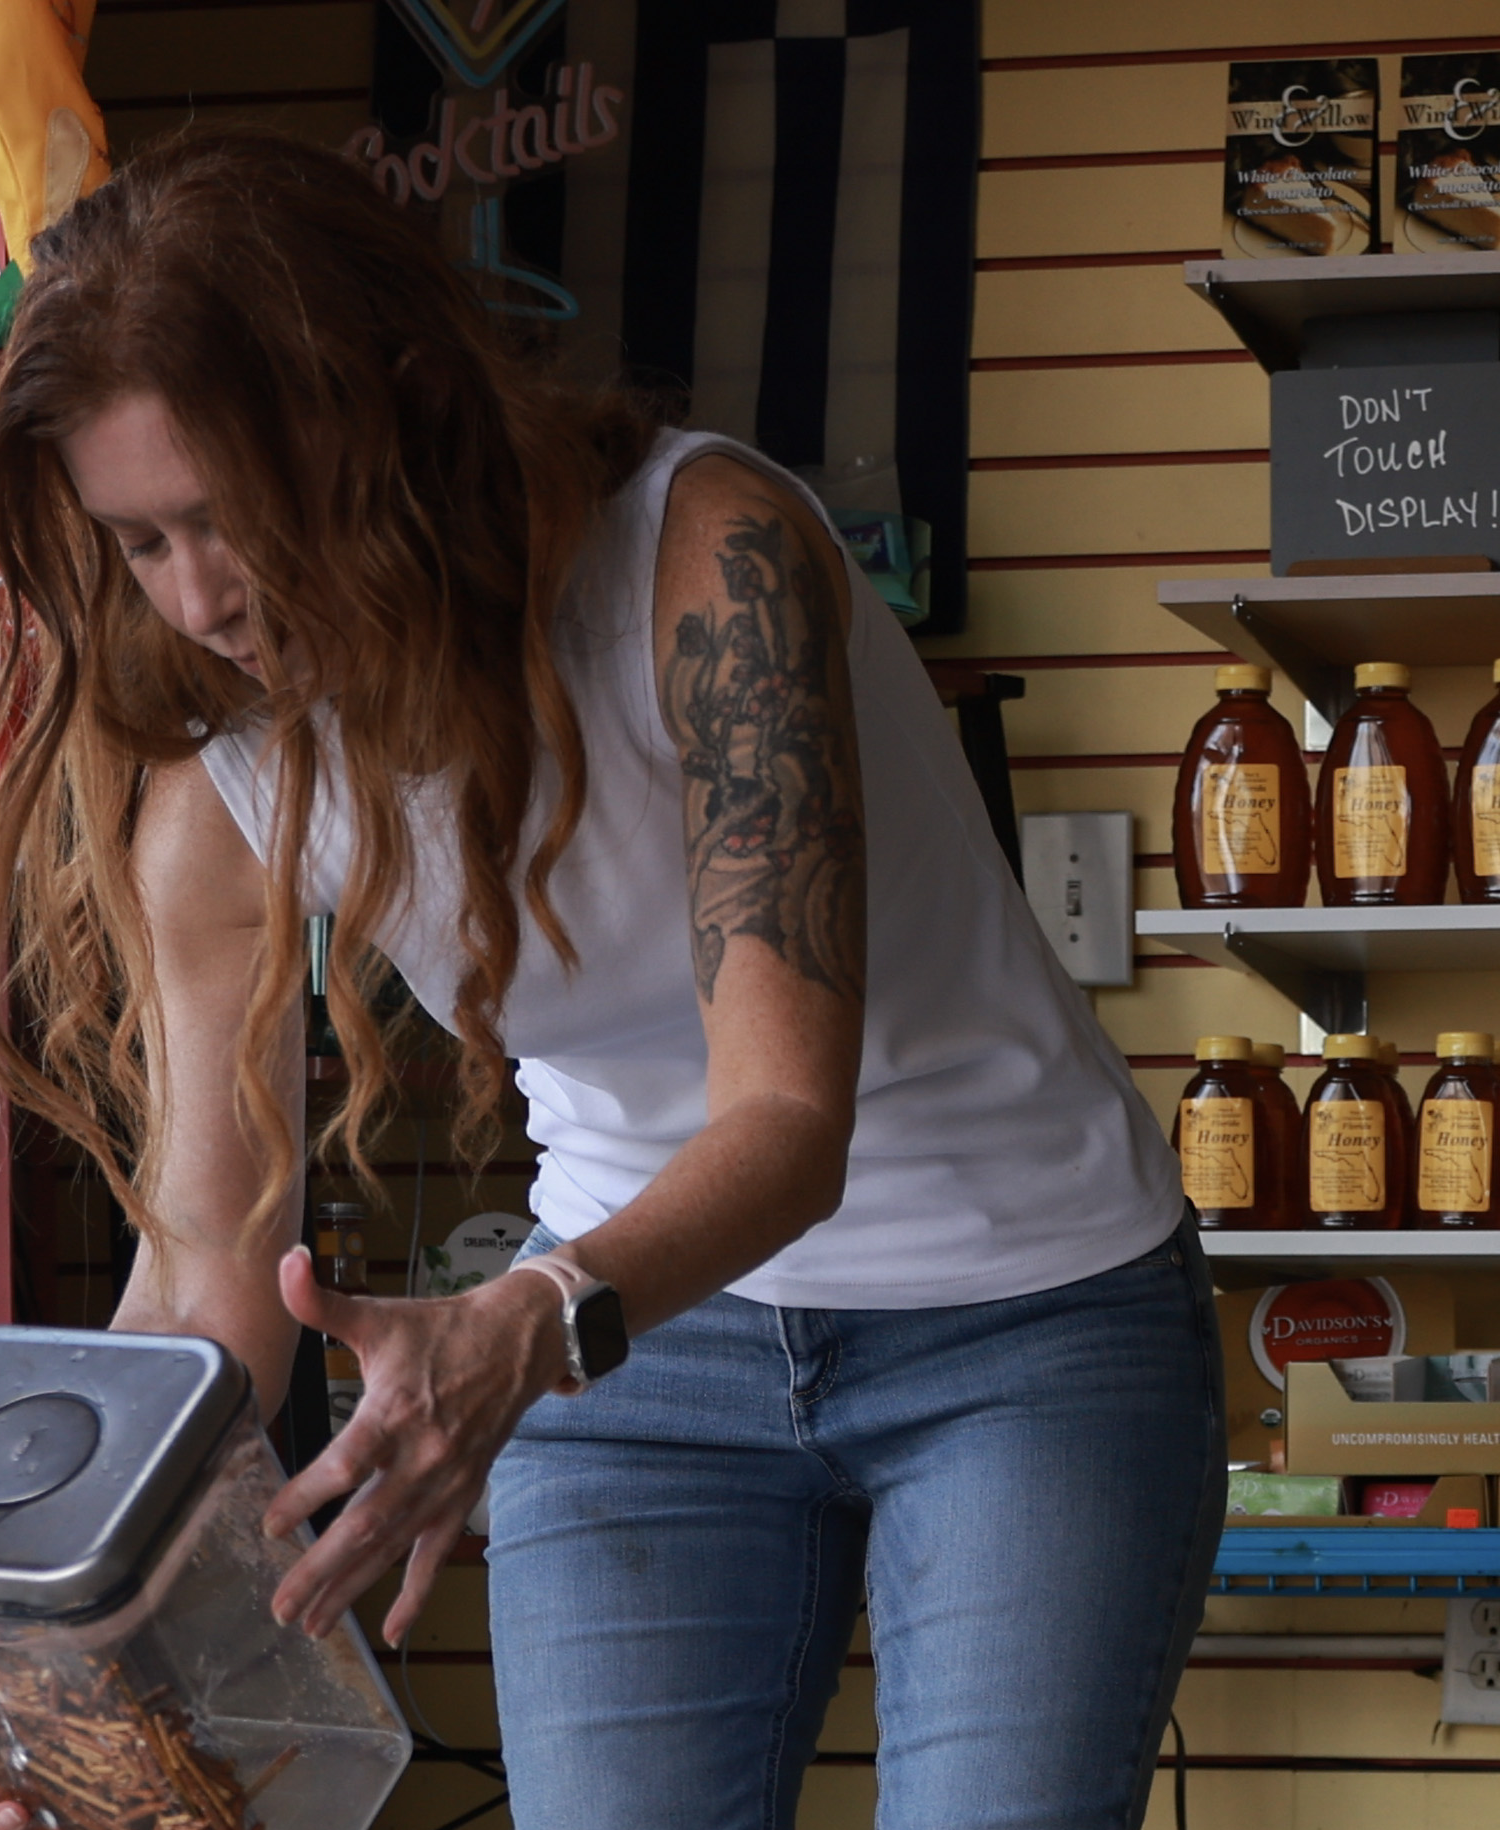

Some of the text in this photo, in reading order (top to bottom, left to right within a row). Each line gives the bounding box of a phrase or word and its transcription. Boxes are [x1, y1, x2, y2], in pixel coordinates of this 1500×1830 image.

[1231, 102, 1371, 129] Wind Willow
[1403, 101, 1457, 124] Wind
[1236, 167, 1357, 185] White Chocolate
[1408, 163, 1451, 179] White
[1339, 387, 1433, 430] DON'T
[1323, 429, 1447, 478] TOUCH
[1224, 796, 1276, 812] Honey
[1352, 797, 1400, 813] Honey
[1273, 1314, 1382, 1339] DAVIDSON'S
[1295, 1335, 1359, 1346] ORGANICS
[1332, 1433, 1460, 1446] UNCOMPROMISINGLY
